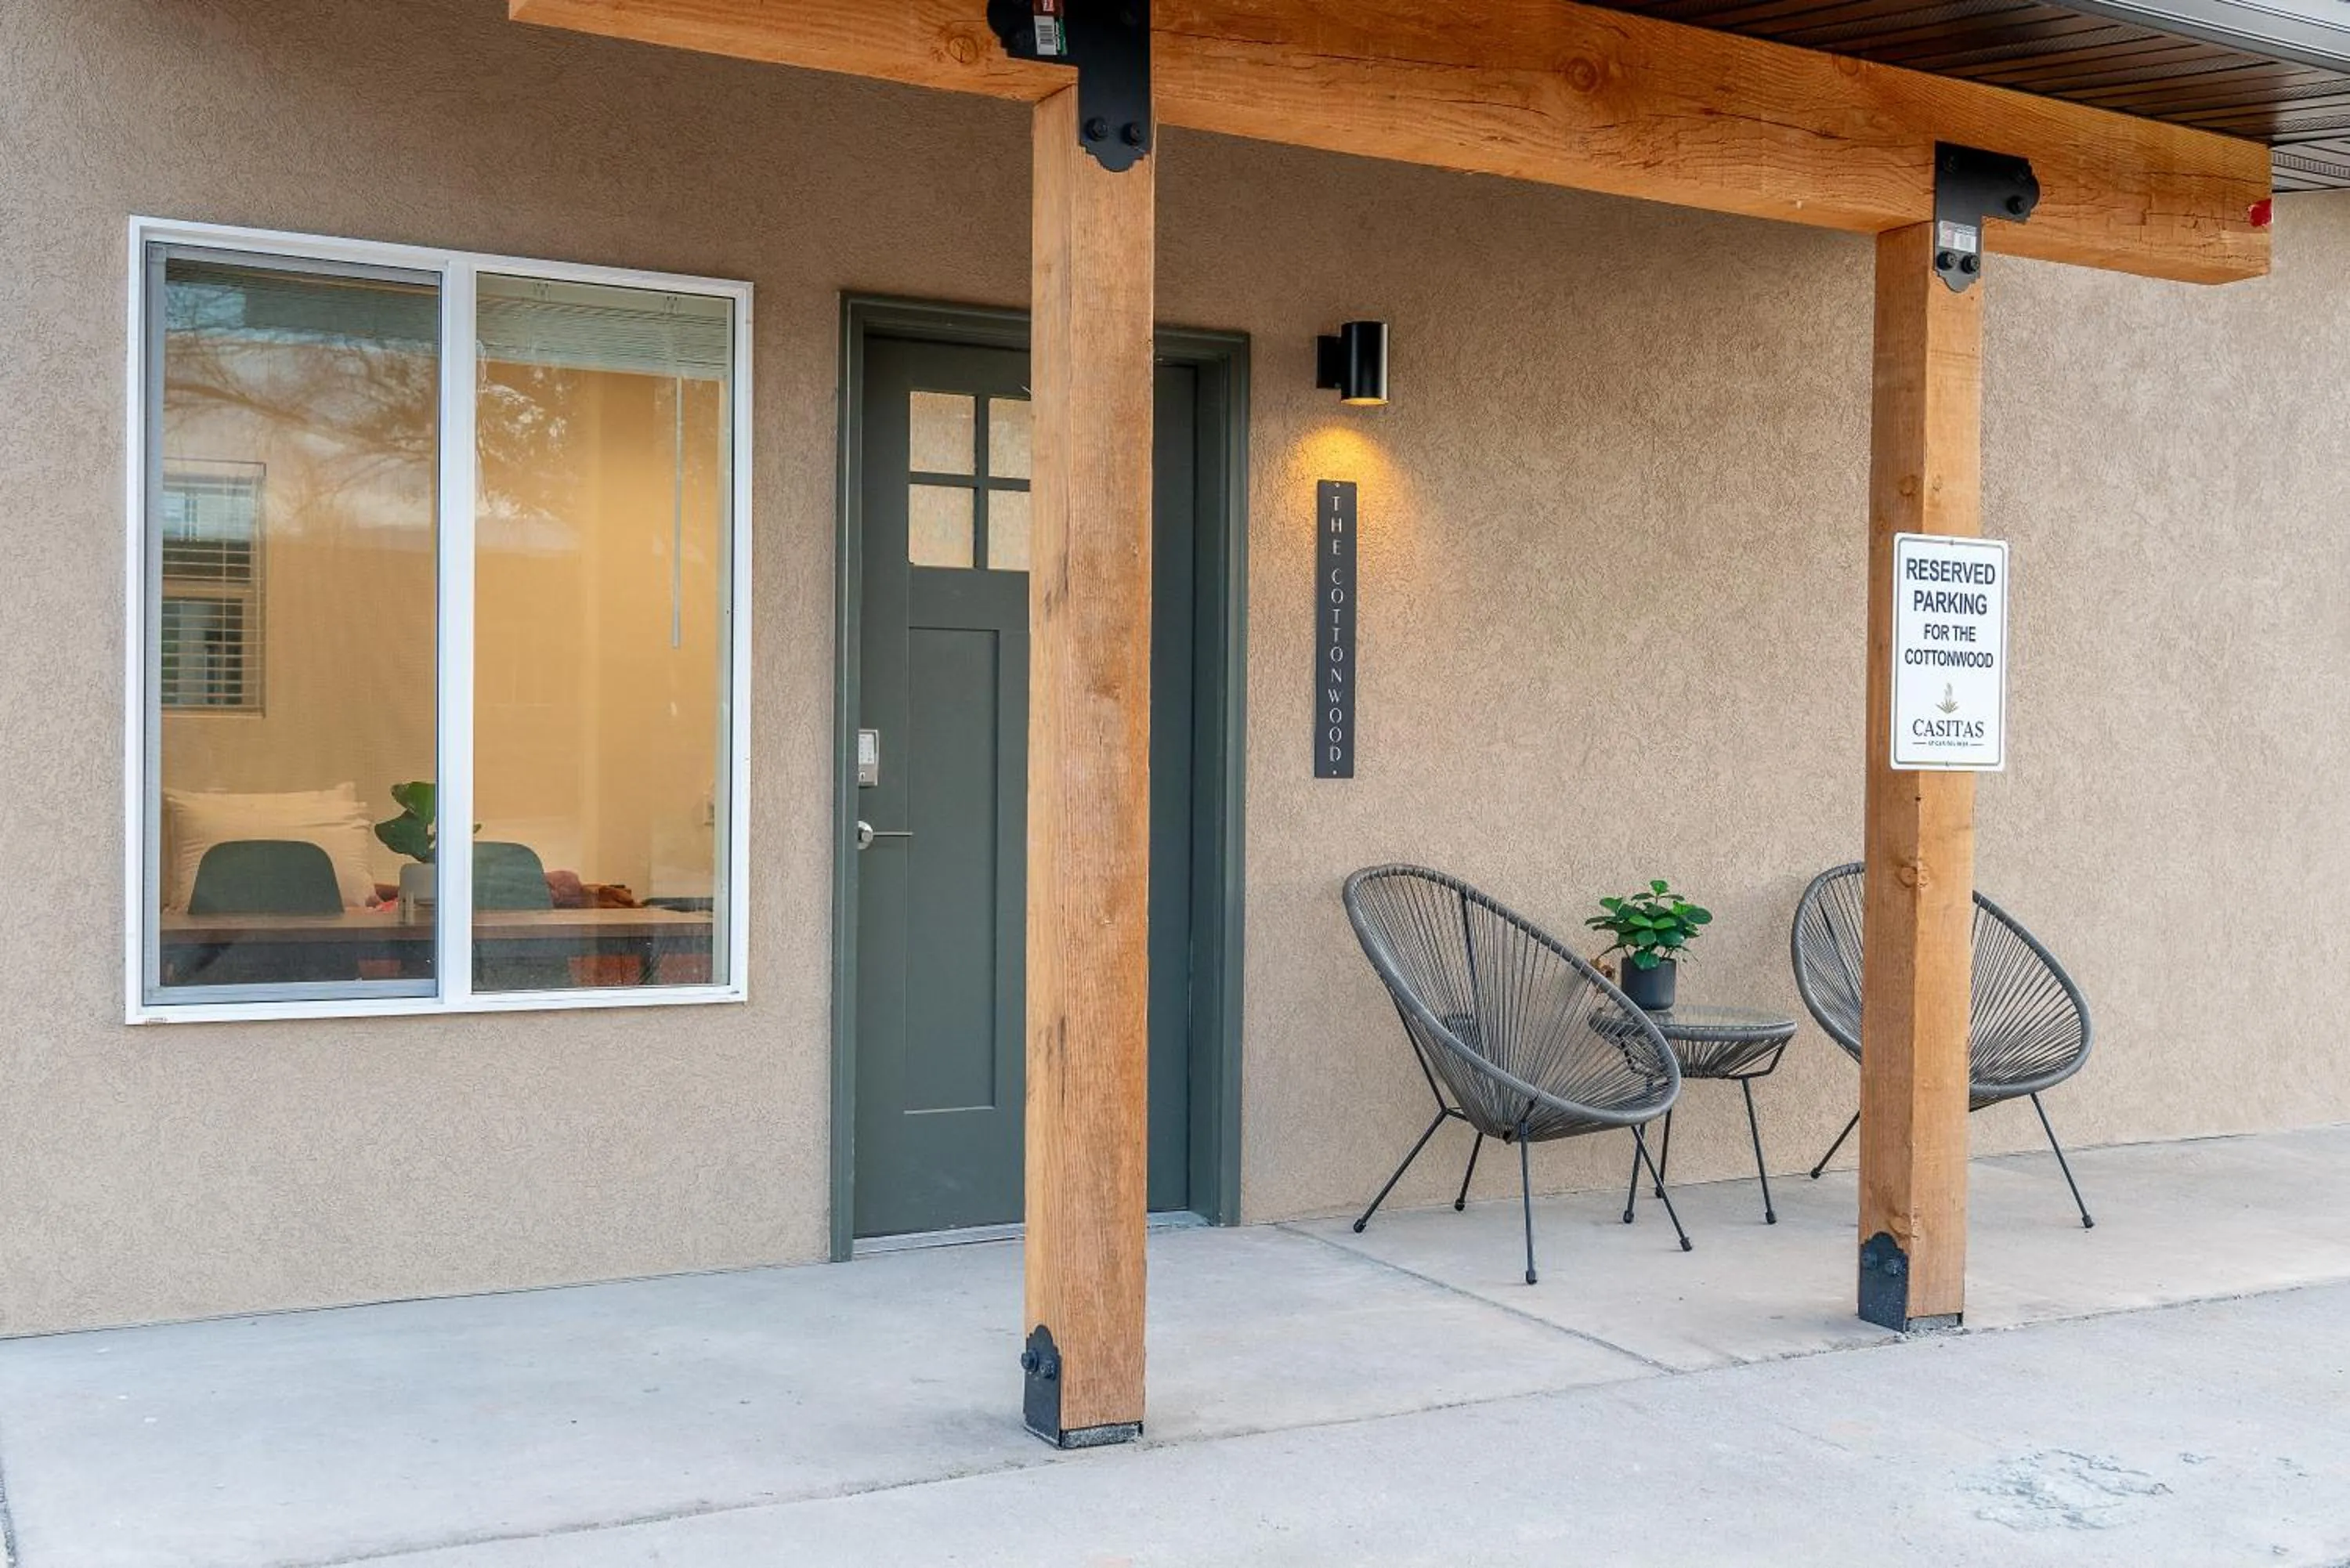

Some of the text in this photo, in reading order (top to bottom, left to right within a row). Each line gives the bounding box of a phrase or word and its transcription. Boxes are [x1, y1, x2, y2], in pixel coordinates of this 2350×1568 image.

[1906, 558, 1996, 585] RESERVED
[1913, 590, 1987, 615] PARKING
[1328, 496, 1344, 763] THE COTTONWOOD
[1924, 623, 1976, 642] FOR THE
[1904, 649, 1994, 668] COTTONWOOD
[1912, 718, 1984, 739] CASITAS
